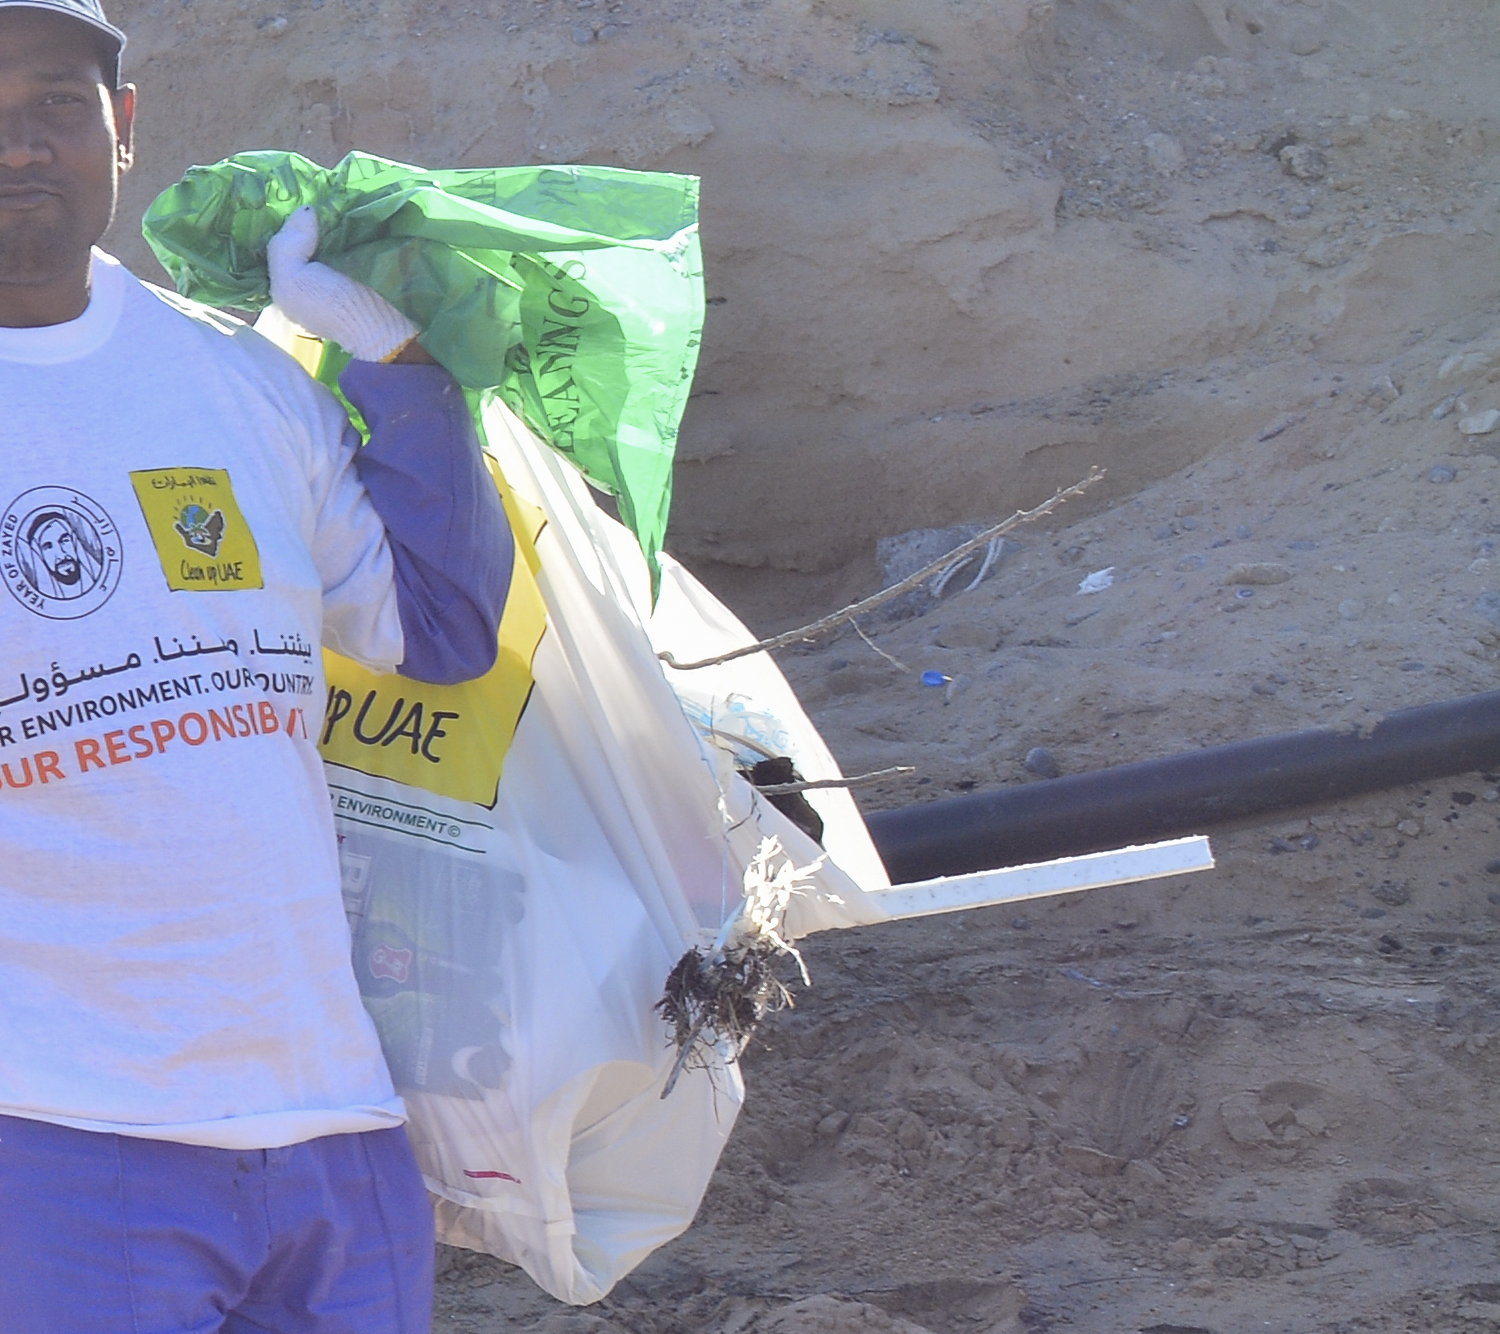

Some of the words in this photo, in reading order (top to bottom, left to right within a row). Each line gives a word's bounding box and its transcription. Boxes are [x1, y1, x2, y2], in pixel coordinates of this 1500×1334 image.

[2, 514, 18, 556] ZAYED
[3, 563, 19, 579] OF
[16, 579, 45, 609] YEAR
[20, 674, 210, 740] ENVIRONMENT.
[211, 667, 256, 692] OUR
[353, 689, 460, 763] UAE
